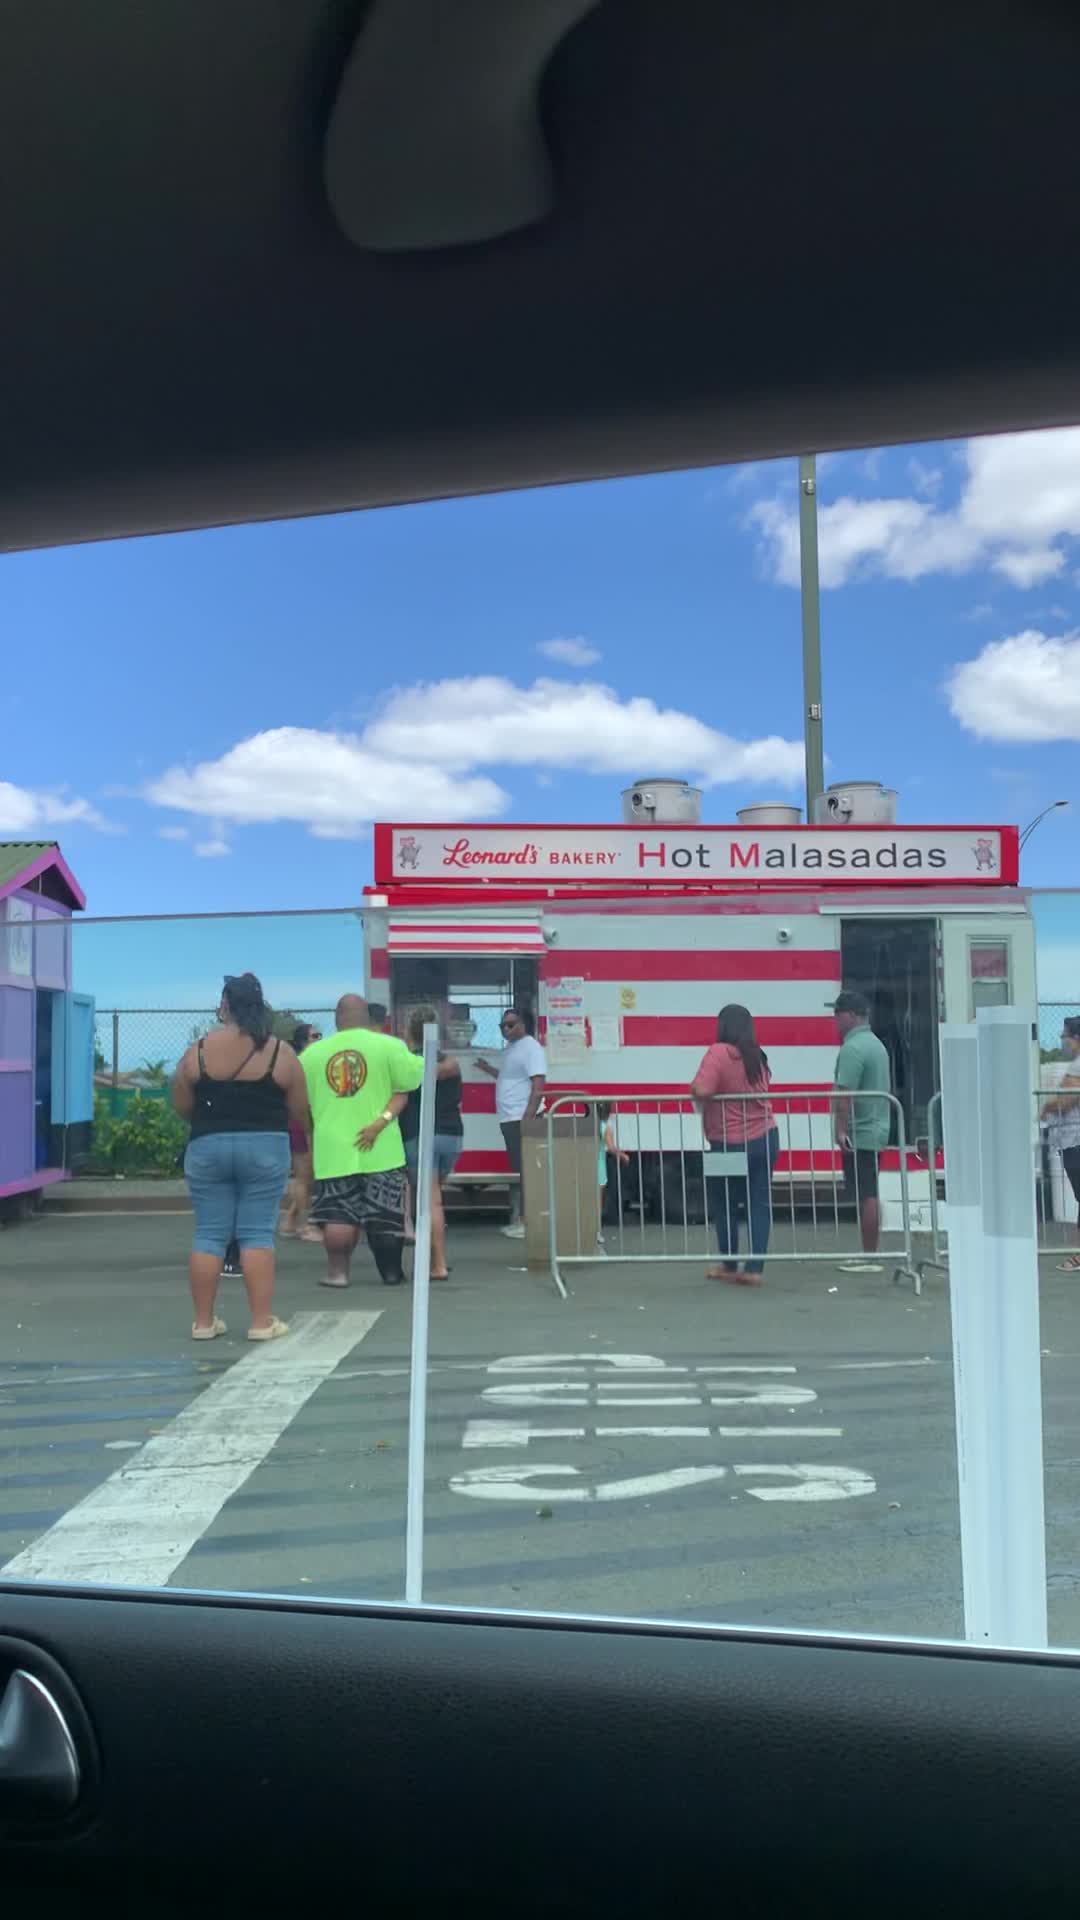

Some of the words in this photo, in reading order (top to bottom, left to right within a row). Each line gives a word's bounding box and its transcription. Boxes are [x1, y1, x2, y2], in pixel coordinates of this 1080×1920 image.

[443, 838, 538, 868] Leonard's
[550, 852, 617, 864] BAKERY
[638, 842, 710, 868] Hot
[729, 842, 947, 868] Malasadas
[449, 1353, 877, 1501] STOP
